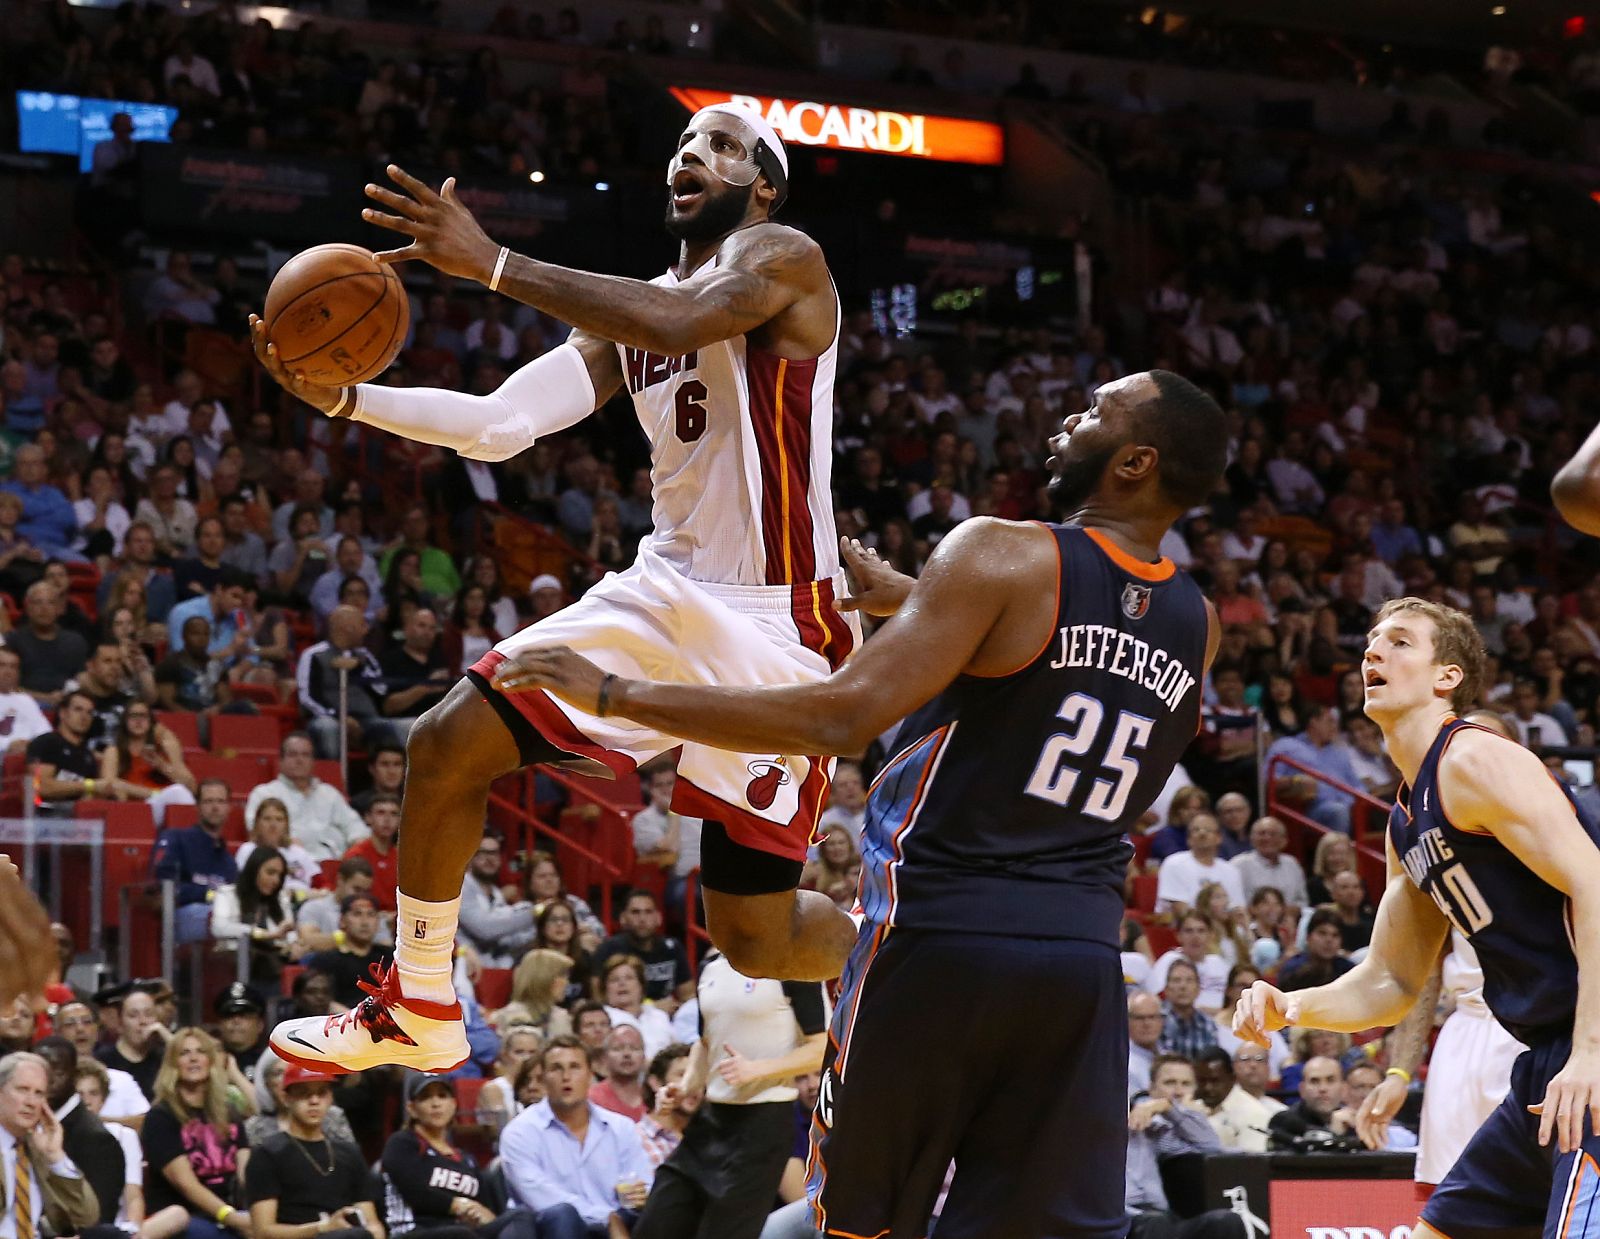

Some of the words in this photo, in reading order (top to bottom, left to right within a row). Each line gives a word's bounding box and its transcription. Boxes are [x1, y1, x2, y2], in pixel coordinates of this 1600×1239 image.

[674, 379, 708, 444] 6
[1050, 624, 1196, 713] JEFFERSON
[1023, 691, 1157, 823] 25
[428, 1166, 481, 1198] HEAT
